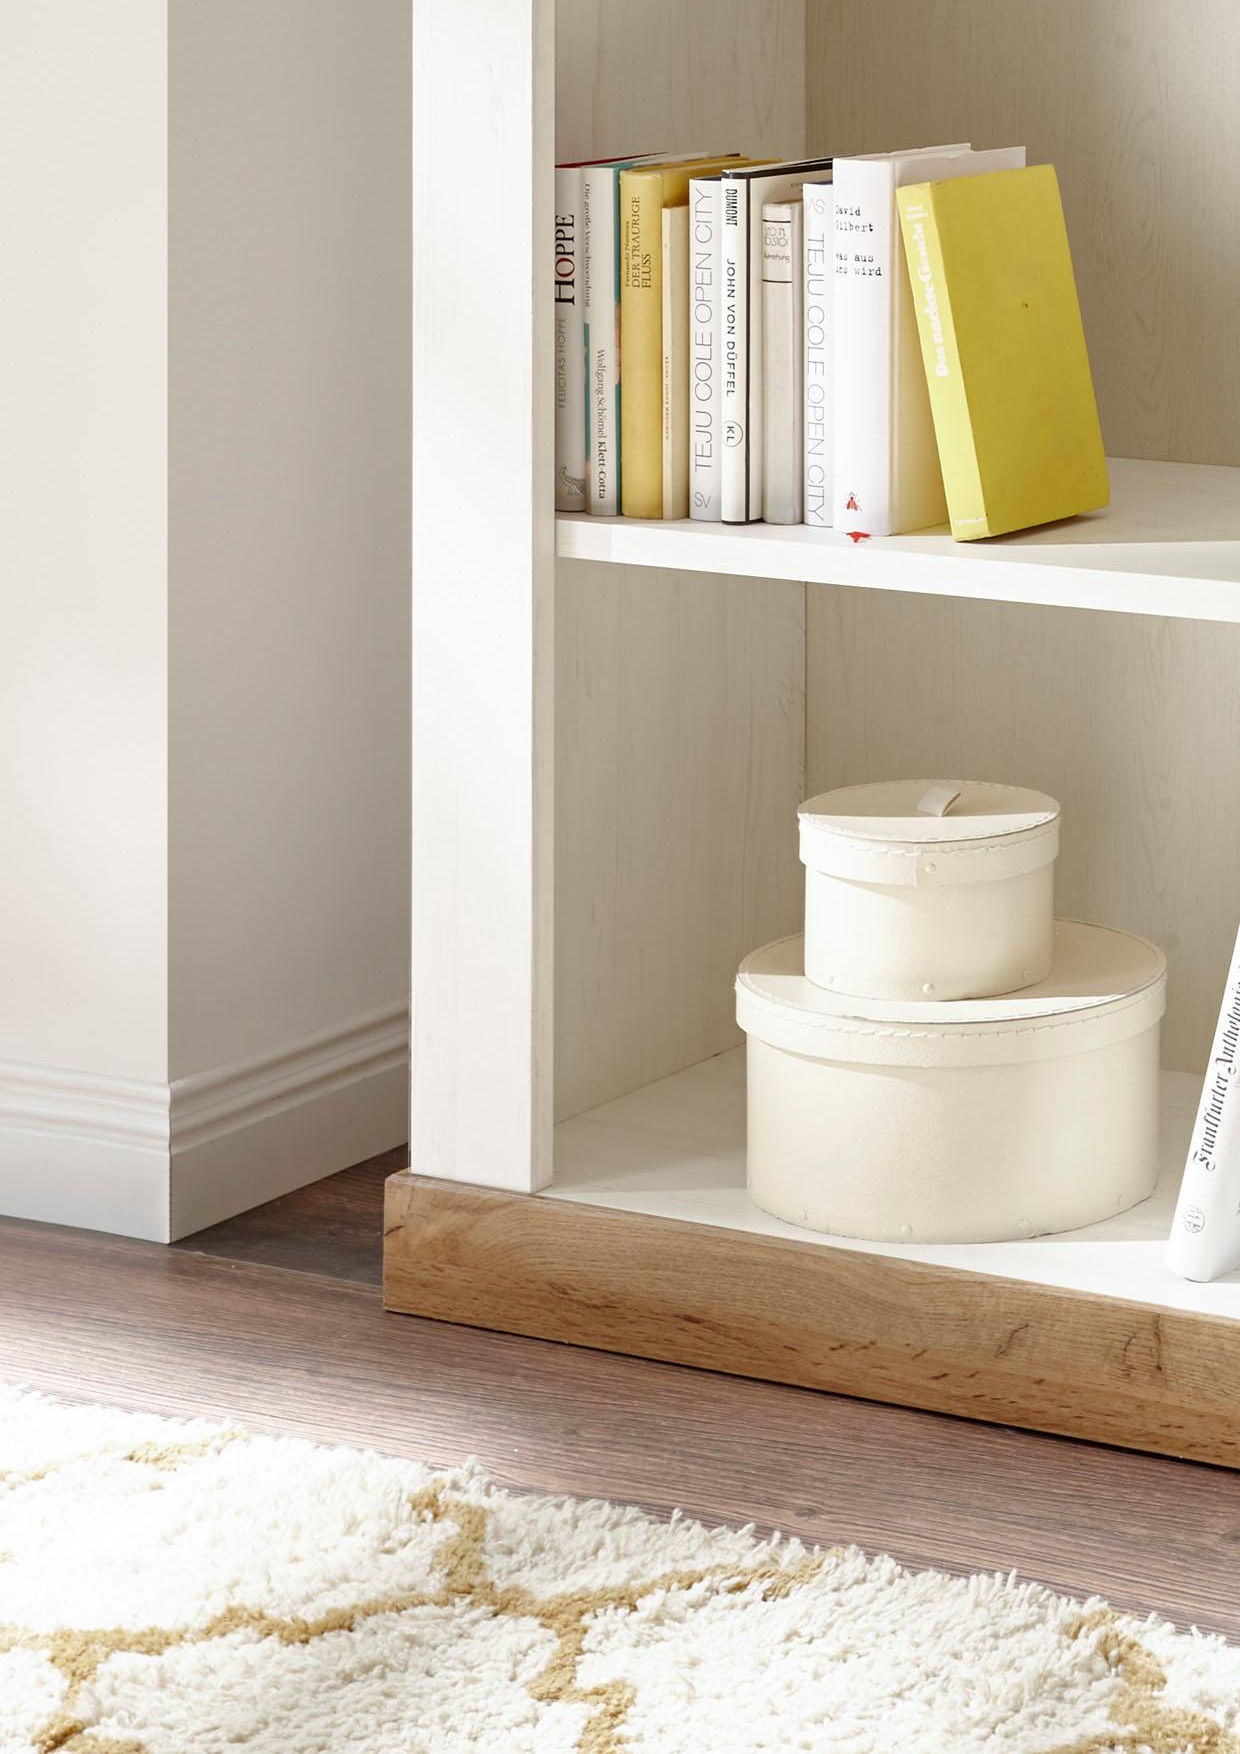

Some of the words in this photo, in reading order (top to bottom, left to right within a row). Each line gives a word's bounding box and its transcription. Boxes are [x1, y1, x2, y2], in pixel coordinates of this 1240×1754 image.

[632, 196, 641, 260] TRAURIGE
[694, 187, 712, 244] CITY
[726, 188, 738, 226] DUMONT
[555, 214, 575, 306] HOPPE
[632, 263, 641, 288] DER
[642, 254, 652, 288] FLUSS
[727, 258, 736, 298] JOHN
[807, 232, 825, 296] TEJU
[854, 254, 874, 263] aus
[854, 266, 883, 277] wird
[694, 252, 712, 324] OPEN
[558, 318, 567, 350] HOPPE
[727, 304, 736, 335] VON
[807, 306, 825, 376] COLE
[558, 357, 567, 408] FELICITAS
[595, 349, 607, 396] Wolfgang
[694, 332, 712, 401] COLE
[727, 341, 738, 397] DÜFFEL
[597, 397, 607, 438] Schömel
[694, 410, 712, 472] TEJU
[727, 425, 735, 443] KL
[807, 384, 825, 456] OPEN
[597, 441, 607, 499] Klett-Cotta
[807, 464, 825, 521] CITY
